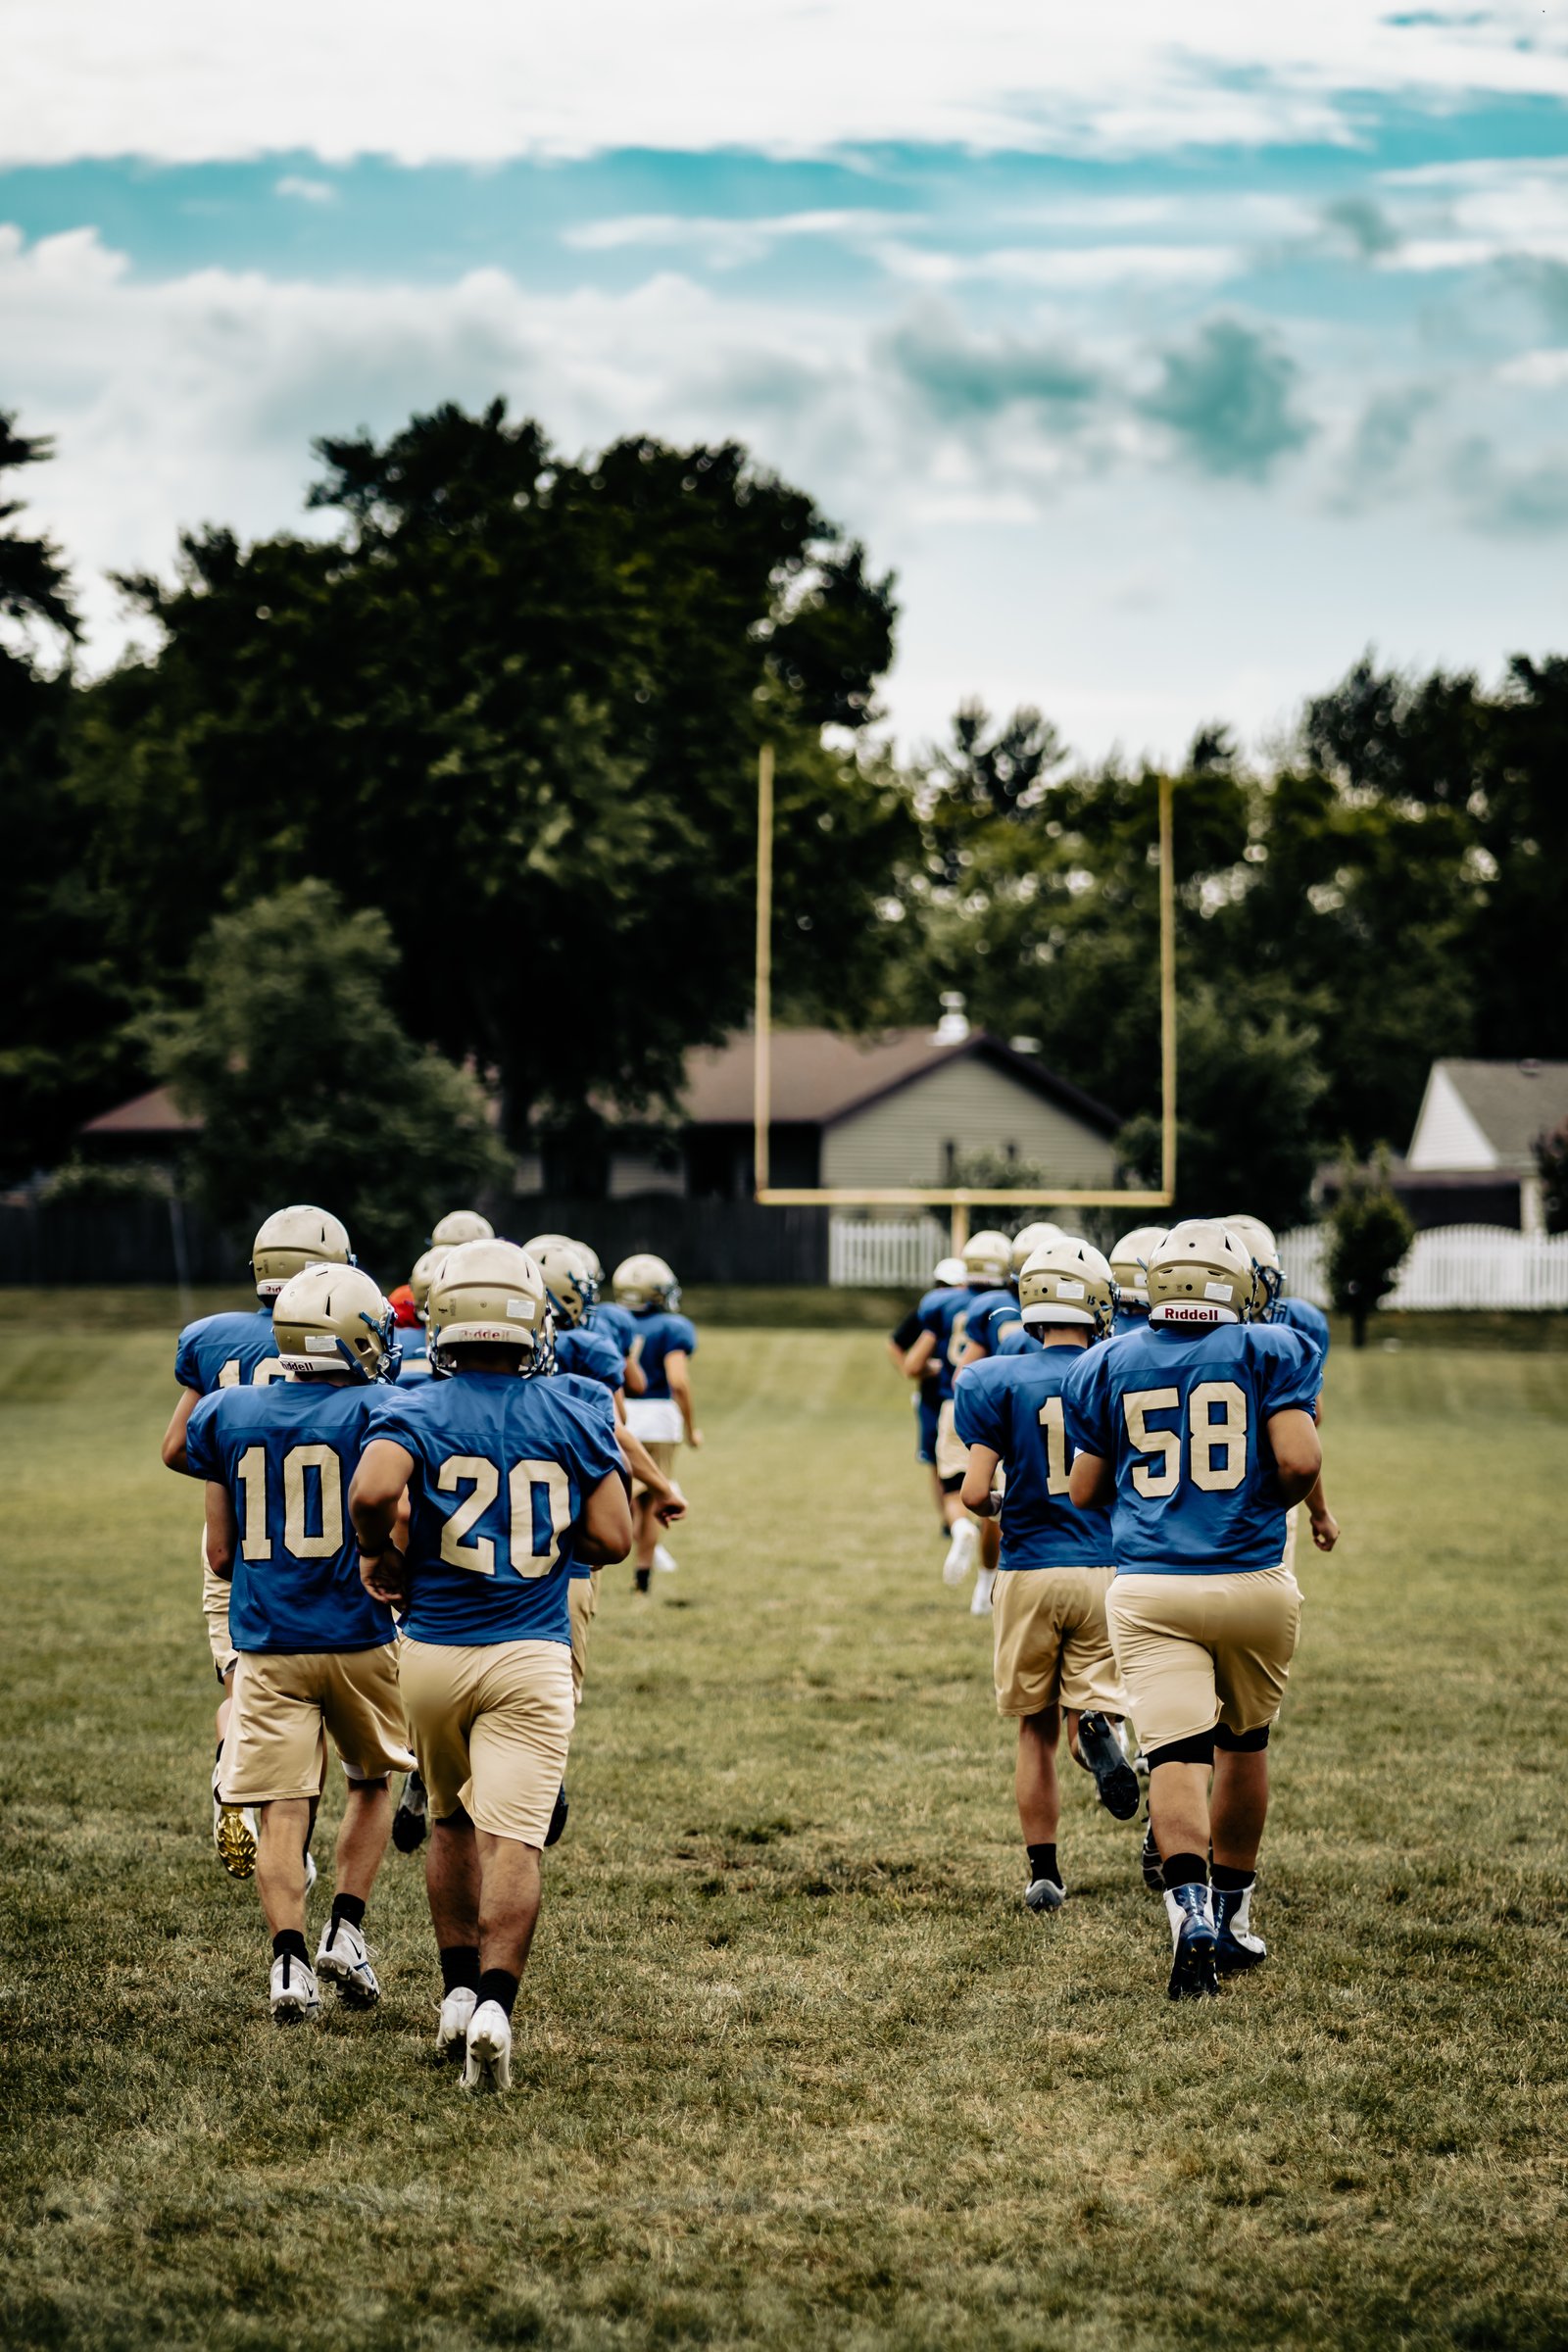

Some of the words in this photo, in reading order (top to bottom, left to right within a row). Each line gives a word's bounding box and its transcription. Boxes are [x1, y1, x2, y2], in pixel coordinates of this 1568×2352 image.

[1087, 1295, 1097, 1306] 15
[1164, 1307, 1219, 1321] Riddell
[1123, 1382, 1249, 1498] 58
[237, 1445, 344, 1561] 10
[437, 1455, 571, 1579] 20
